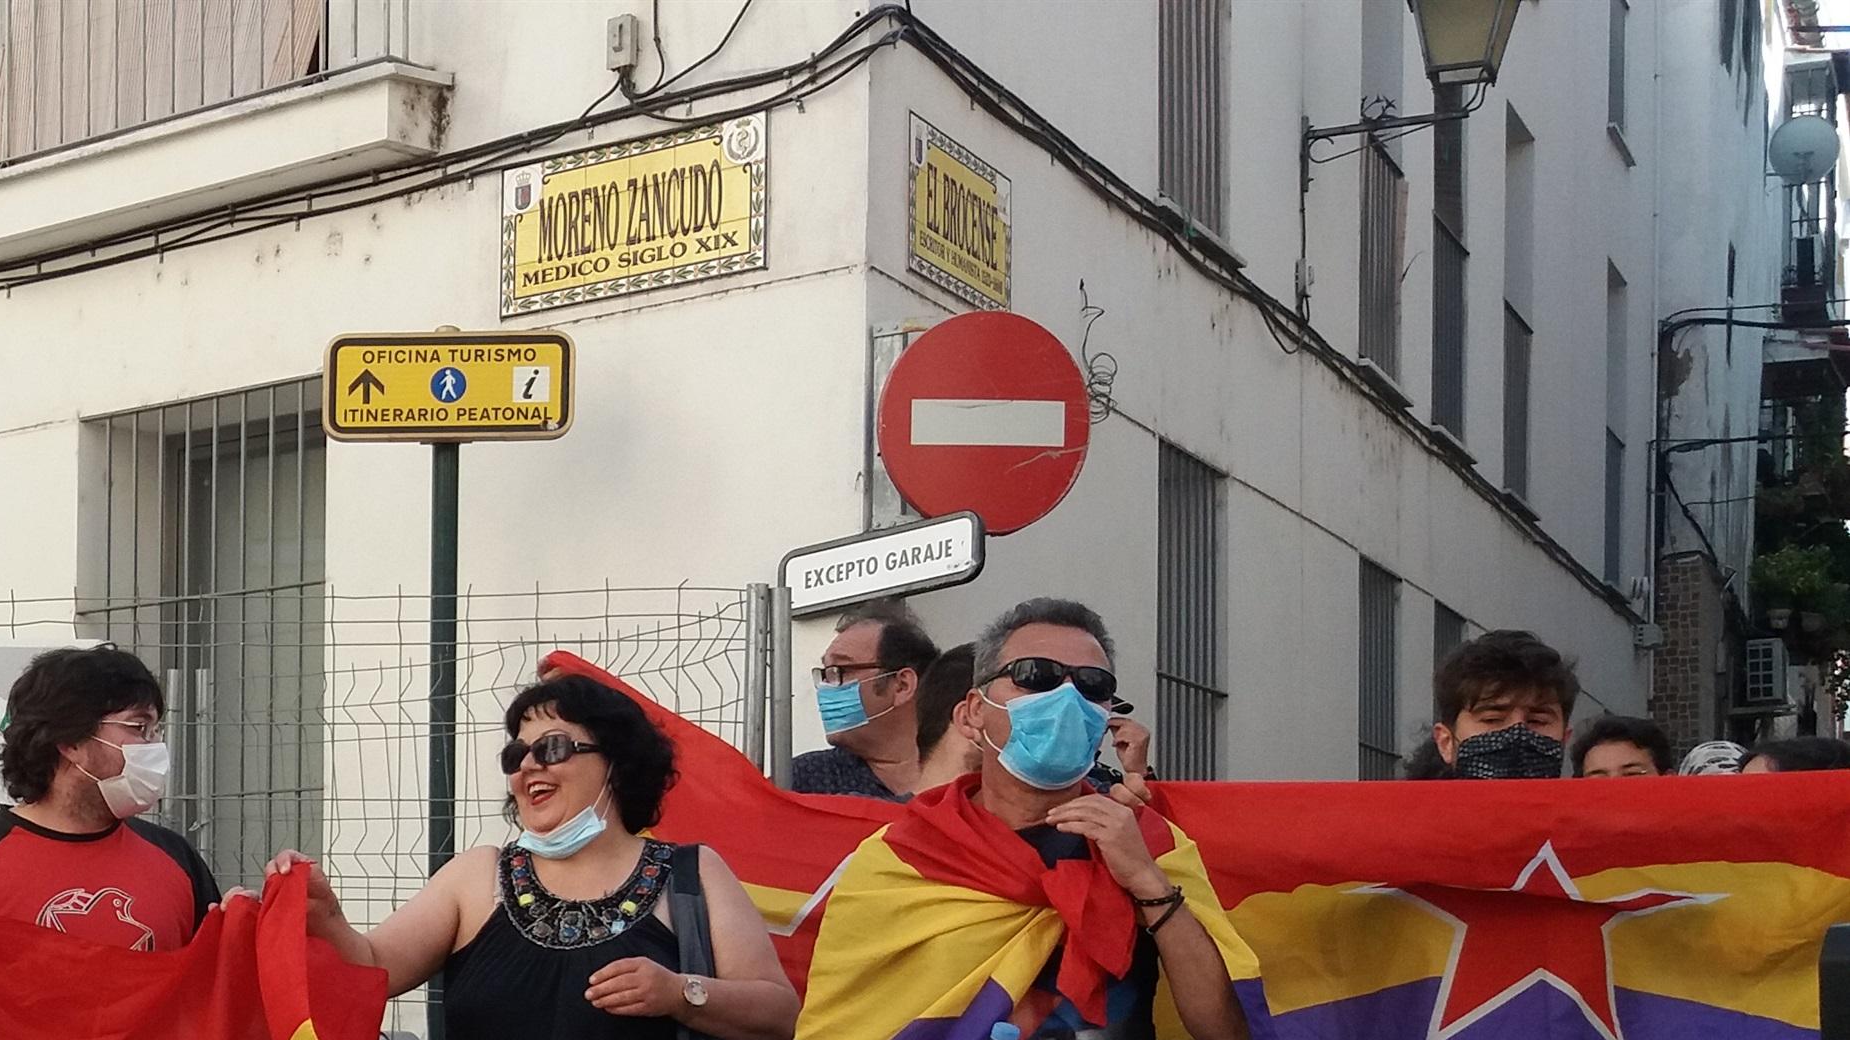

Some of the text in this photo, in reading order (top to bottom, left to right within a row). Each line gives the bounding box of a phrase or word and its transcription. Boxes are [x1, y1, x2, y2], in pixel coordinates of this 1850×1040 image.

[538, 159, 723, 263] MORENO ZANCUDO
[926, 162, 999, 271] EL BROCENSE
[522, 231, 740, 288] MEDICO SIGLO XIX
[362, 348, 537, 364] OFICINA TURISMO
[343, 407, 553, 423] ITINERARIO PEATONAL
[804, 538, 953, 589] EXCEPTO GARAJE
